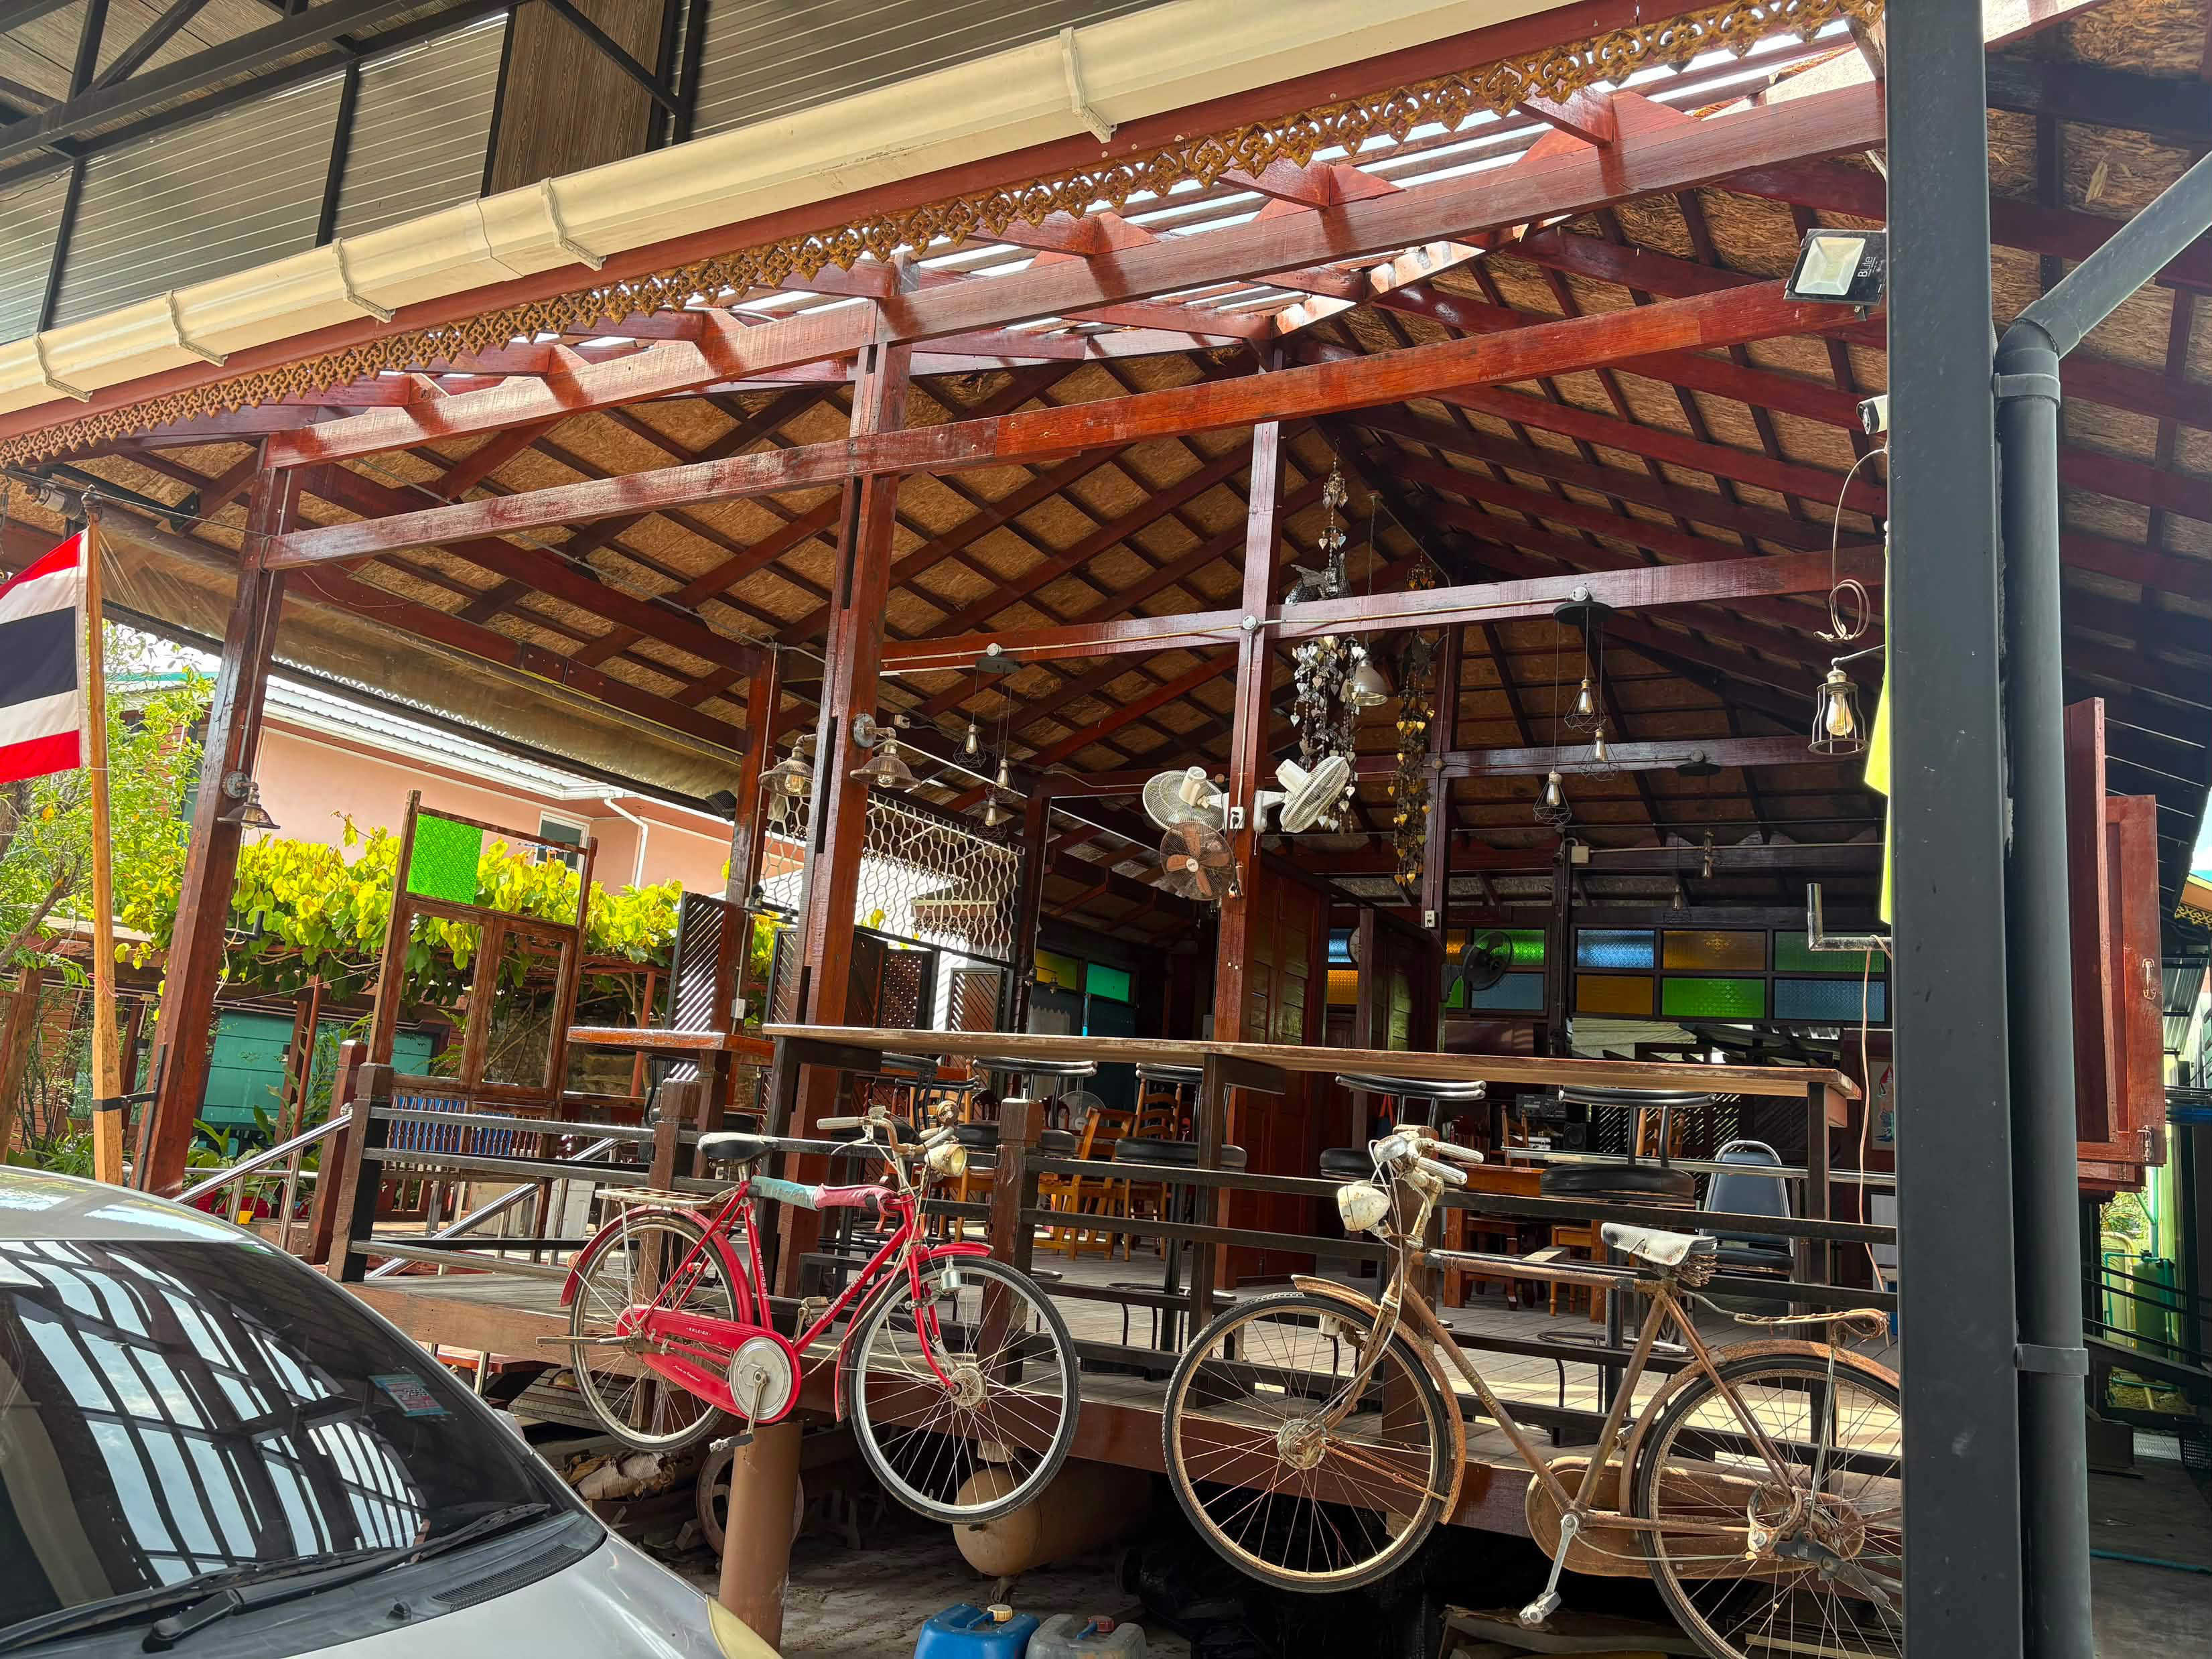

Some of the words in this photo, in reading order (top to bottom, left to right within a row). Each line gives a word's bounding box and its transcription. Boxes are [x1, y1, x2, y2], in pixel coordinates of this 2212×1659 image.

[756, 1248, 767, 1288] RALEIGH
[821, 1295, 843, 1321] RALEIGH
[845, 1272, 864, 1295] SPORTS
[1478, 1388, 1498, 1412] SPORTS
